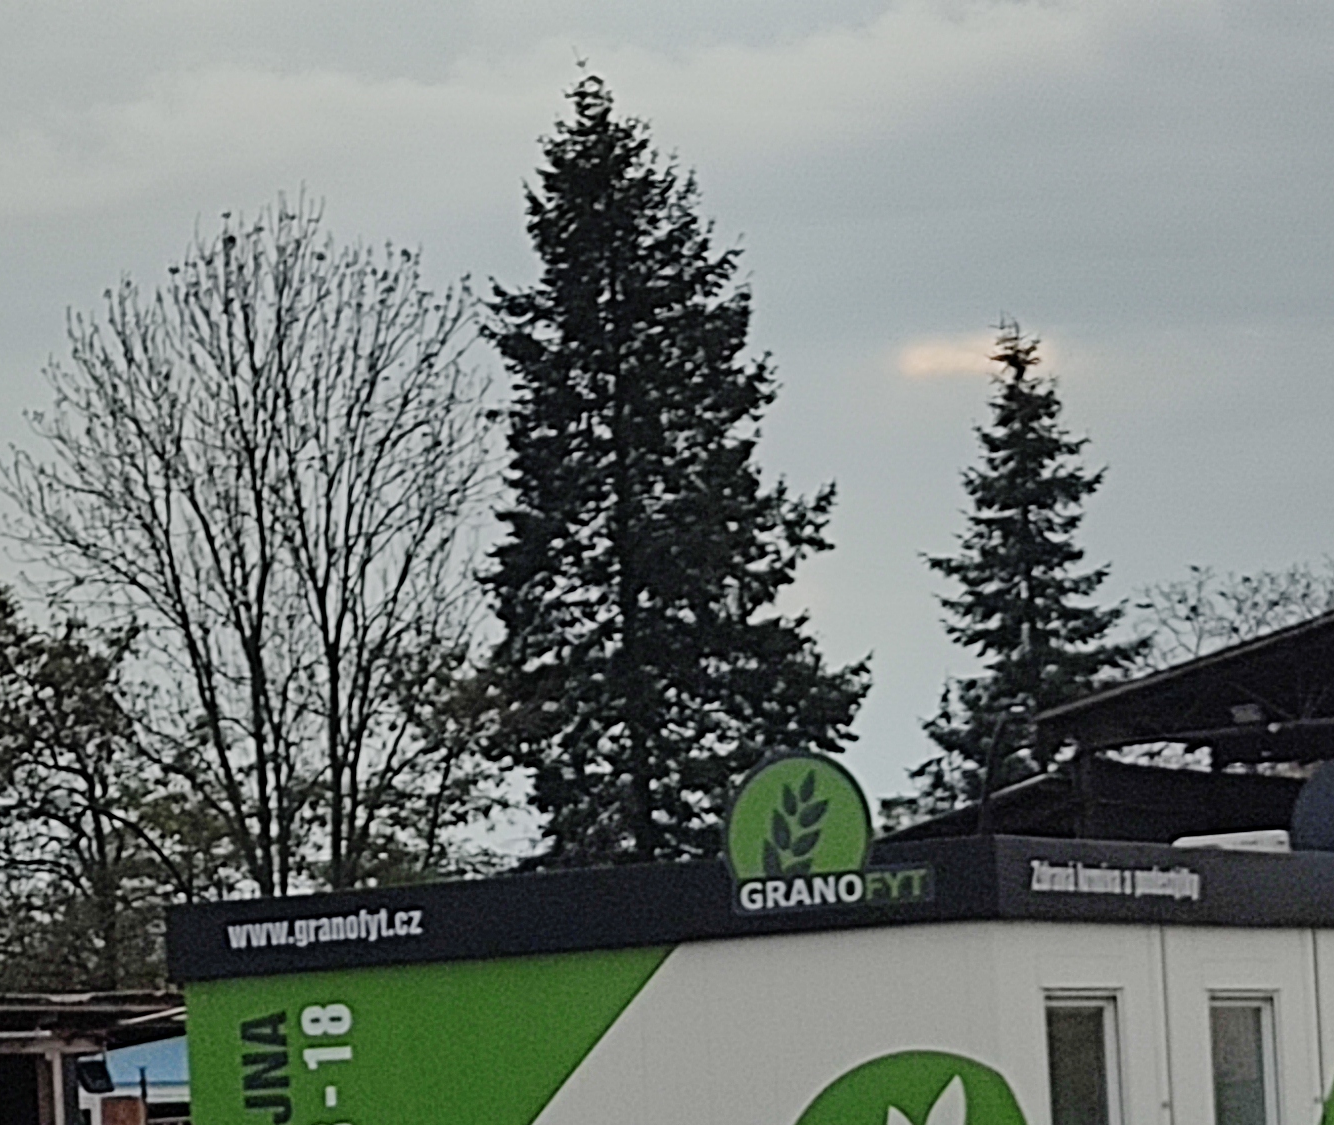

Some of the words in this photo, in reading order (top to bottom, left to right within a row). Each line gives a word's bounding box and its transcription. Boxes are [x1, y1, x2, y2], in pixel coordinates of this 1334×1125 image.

[739, 868, 928, 911] GRANOFYT
[227, 907, 424, 949] www.granofyt.cz
[300, 1002, 354, 1071] 18
